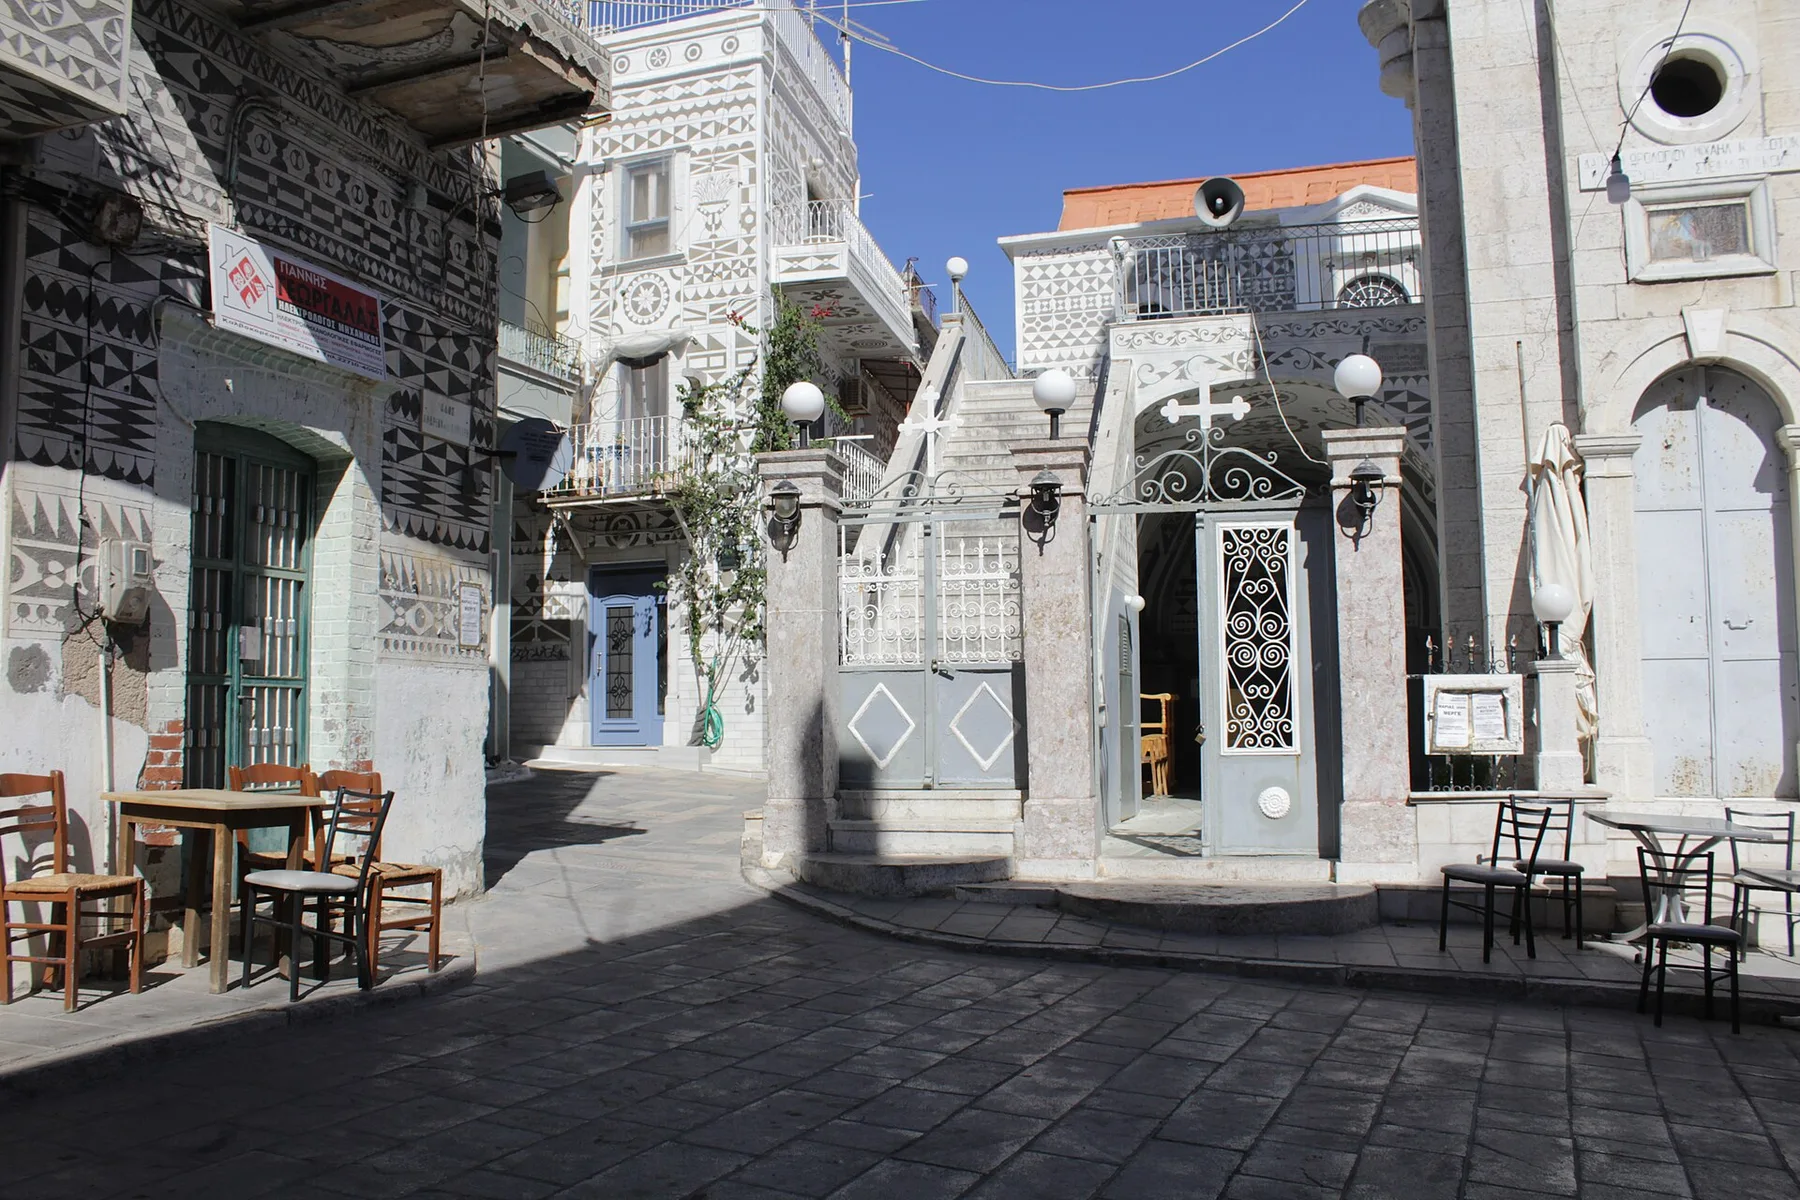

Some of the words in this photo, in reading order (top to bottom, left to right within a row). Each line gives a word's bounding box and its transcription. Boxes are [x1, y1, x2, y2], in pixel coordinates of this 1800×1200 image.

[280, 261, 327, 290] ΓΙΑΝΝΗΣ
[278, 274, 378, 330] ΓΕΩΡΓΑΛΑΣ
[278, 300, 336, 329] ΗΛΕΚΤΡΟΛΟΓΟΣ
[338, 322, 380, 346] ΜΗΧΑΝΙΚΟΣ
